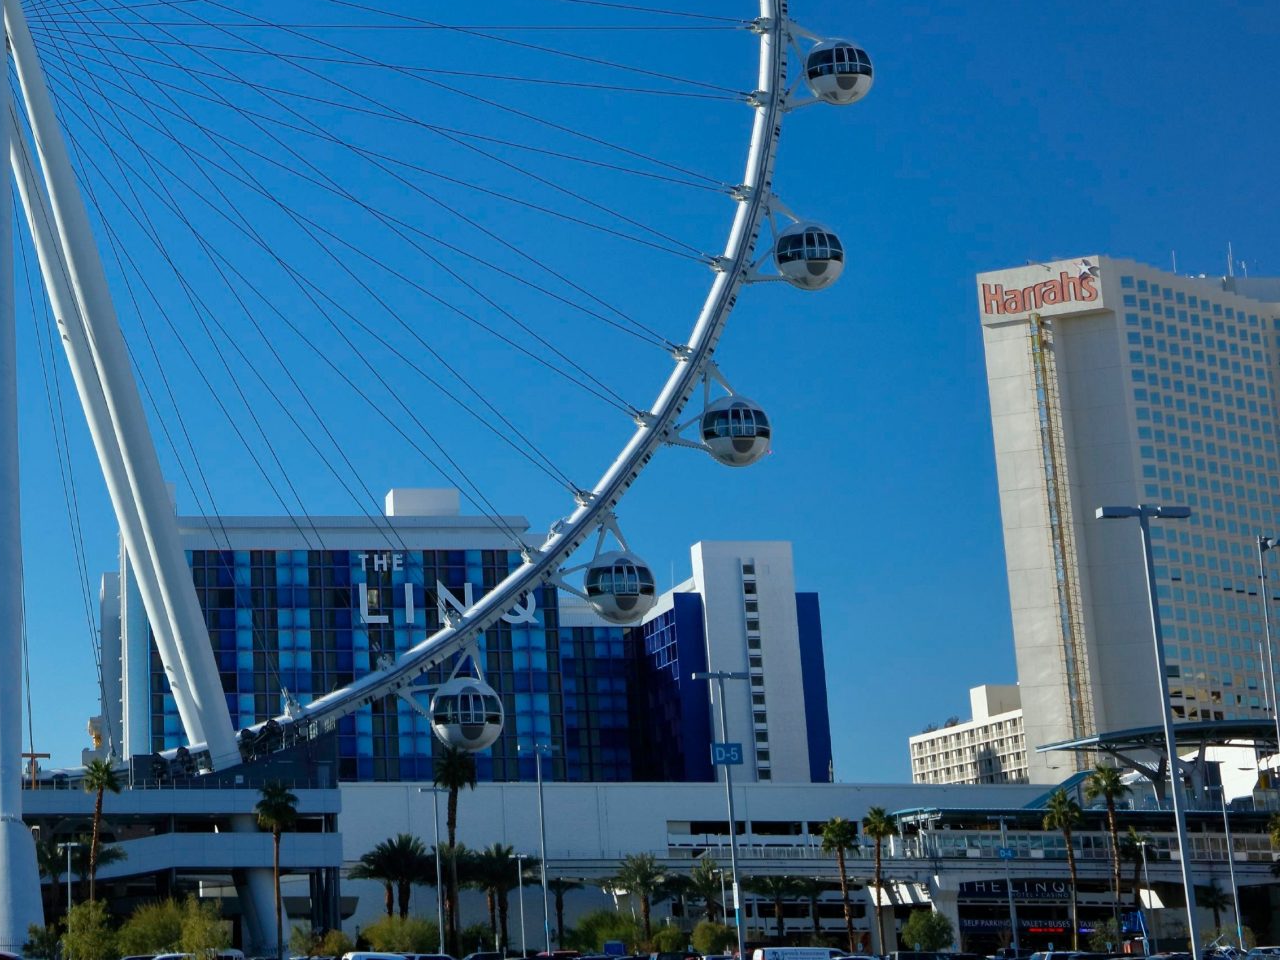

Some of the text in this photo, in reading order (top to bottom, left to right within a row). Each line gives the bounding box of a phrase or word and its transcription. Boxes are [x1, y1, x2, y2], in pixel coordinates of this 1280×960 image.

[358, 554, 404, 572] THE
[715, 747, 739, 761] D-5
[1022, 920, 1043, 928] VALET
[1048, 920, 1071, 928] BUSES
